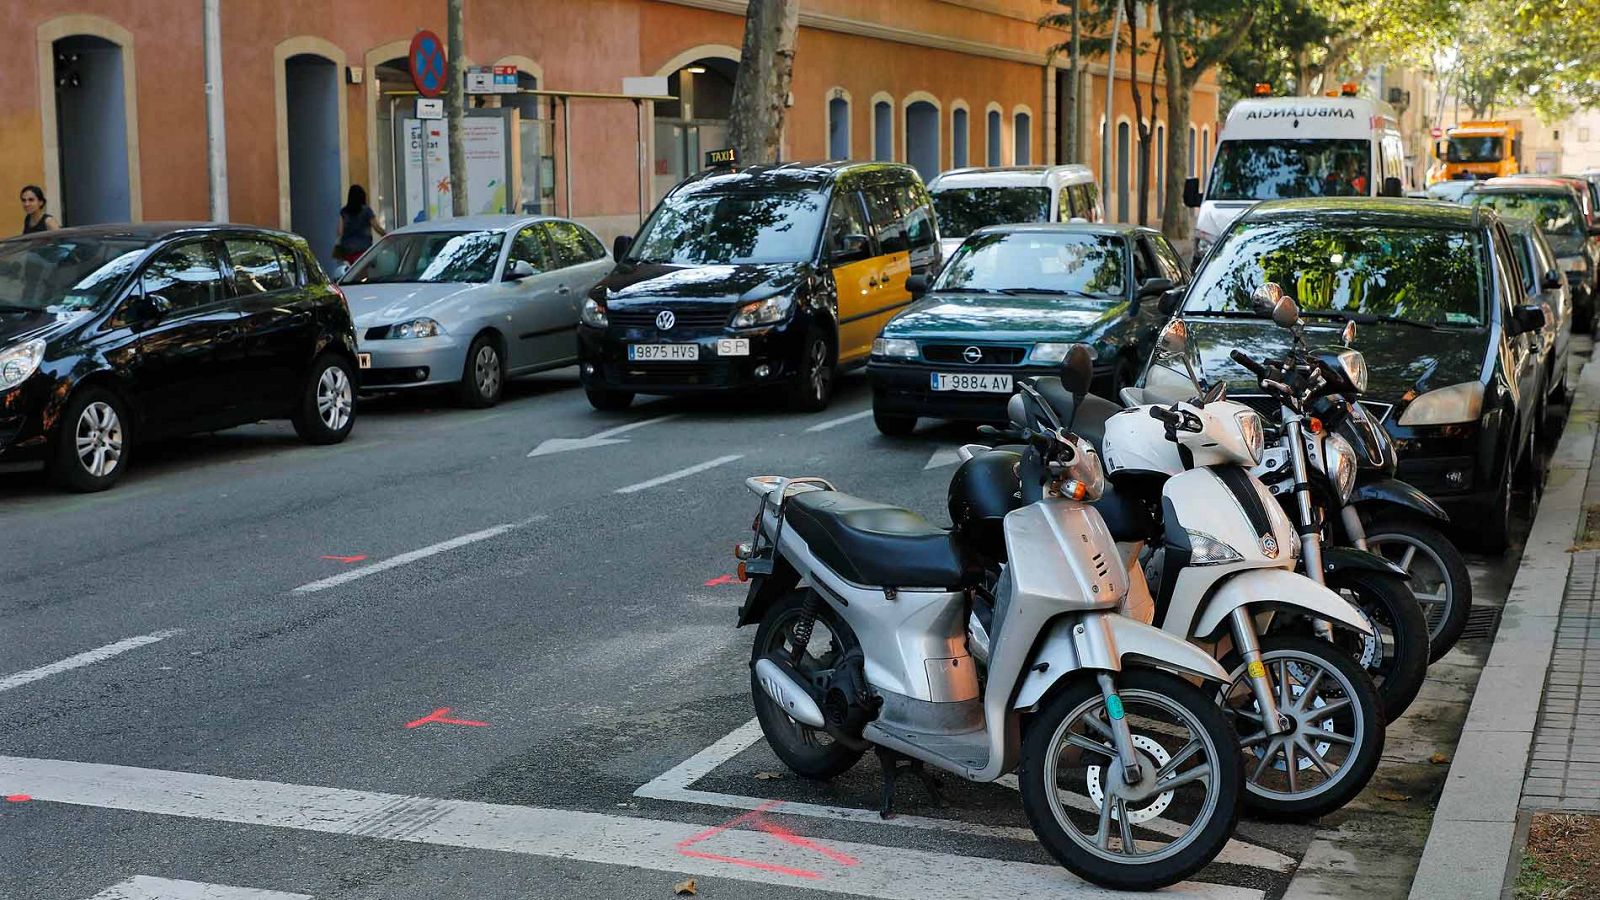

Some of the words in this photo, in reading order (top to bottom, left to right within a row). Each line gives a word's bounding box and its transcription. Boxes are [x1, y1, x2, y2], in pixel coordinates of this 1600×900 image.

[711, 151, 729, 162] TAXI
[636, 345, 668, 358] 9875
[671, 346, 695, 358] HVS
[940, 375, 947, 389] T
[952, 375, 987, 390] 9884
[992, 376, 1009, 390] AV
